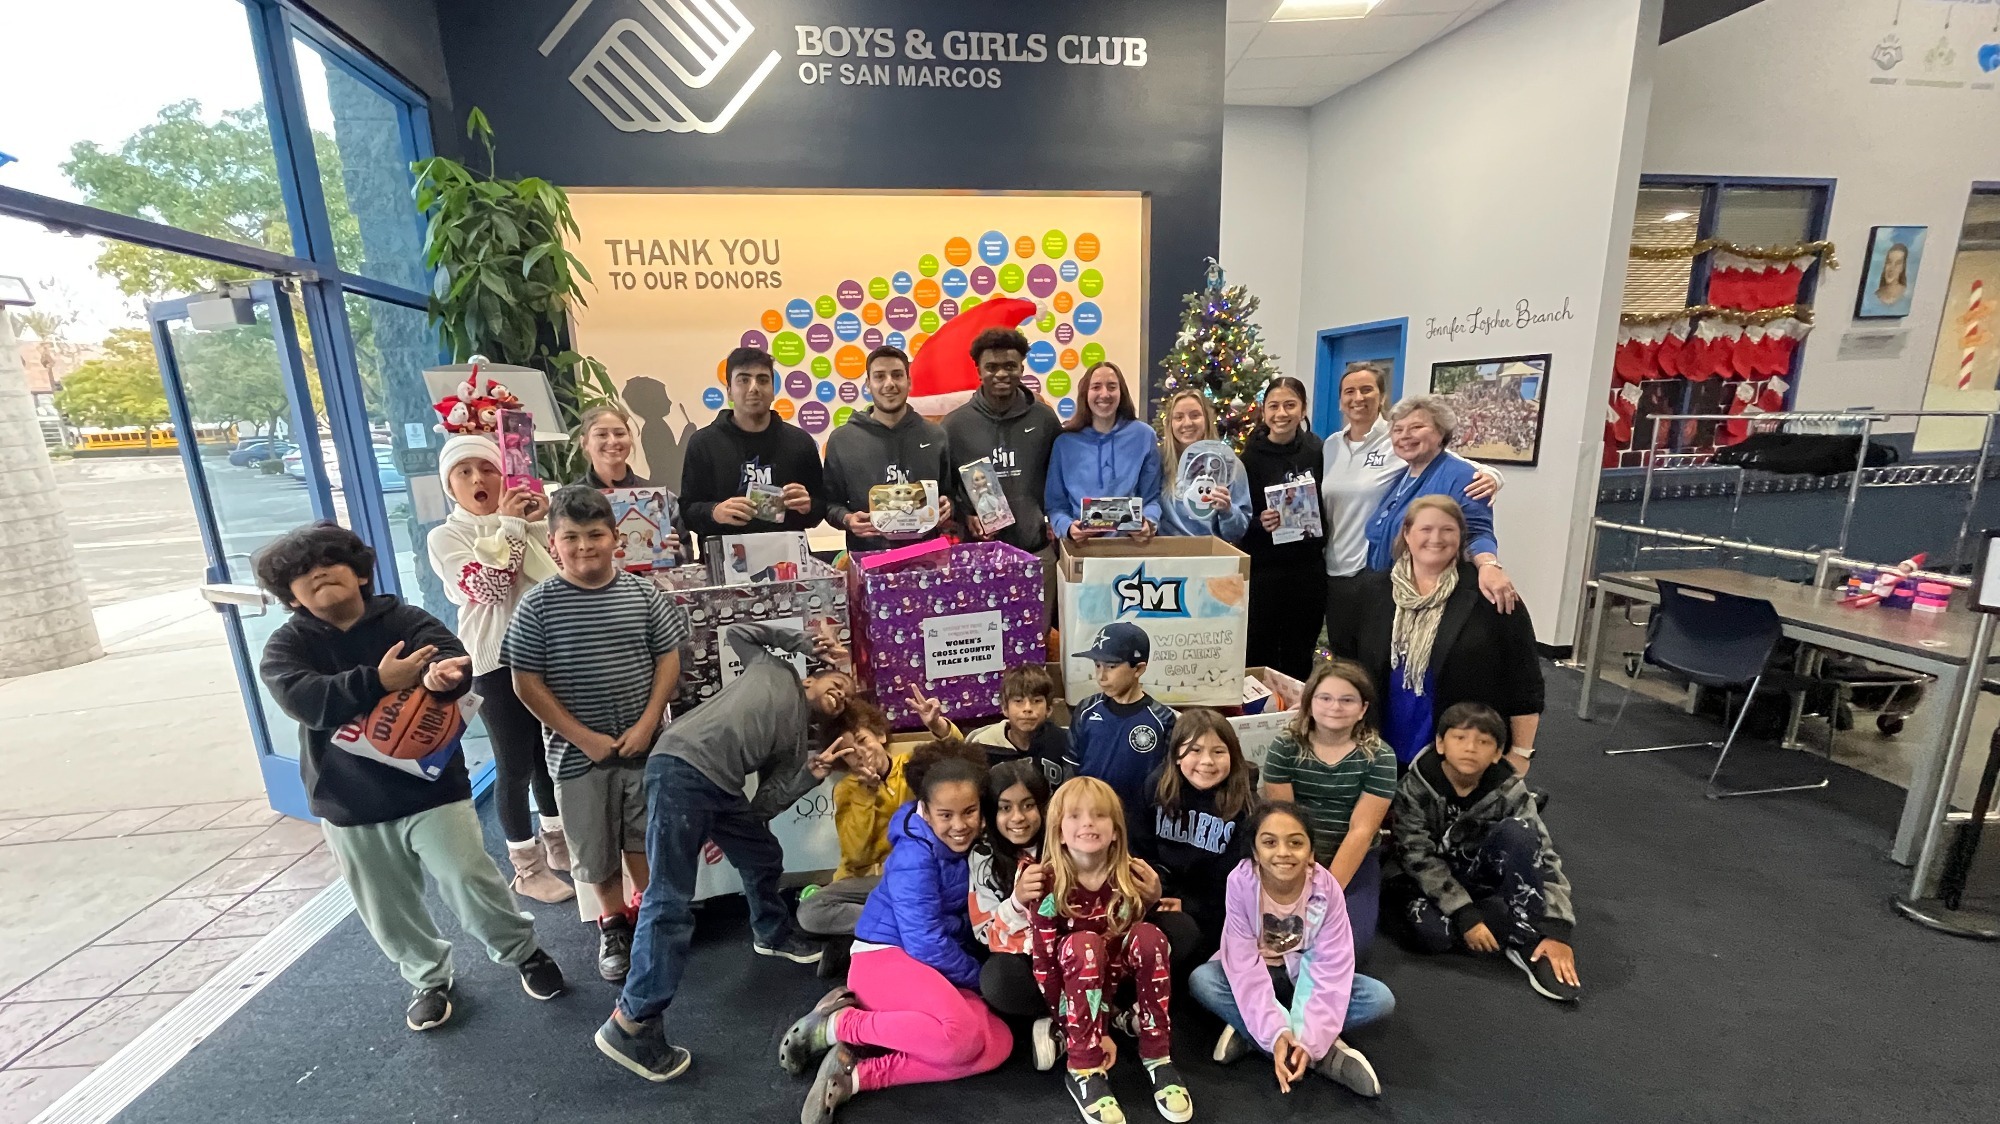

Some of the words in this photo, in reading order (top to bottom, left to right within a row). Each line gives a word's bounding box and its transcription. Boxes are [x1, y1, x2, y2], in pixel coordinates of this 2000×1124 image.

[794, 25, 896, 58] BOYS
[904, 29, 937, 60] &
[943, 30, 1048, 63] GIRLS
[1057, 34, 1148, 67] CLUB
[798, 62, 833, 85] OF
[839, 63, 890, 86] SAN
[897, 65, 1002, 89] MARCOS
[604, 239, 713, 266] THANK
[720, 238, 780, 266] YOU
[609, 271, 637, 290] TO
[643, 271, 688, 290] OUR
[695, 271, 783, 290] DONORS
[1425, 317, 1466, 342] Jennifer
[1512, 296, 1574, 329] Branch
[1366, 452, 1384, 466] SM
[743, 464, 772, 485] SM
[1116, 572, 1180, 612] SM
[932, 649, 957, 658] CROSS
[959, 644, 996, 655] COUNTRY
[945, 637, 982, 647] WOMEN'S
[936, 657, 962, 666] TRACK
[971, 654, 992, 662] FIELD
[1152, 650, 1178, 662] AND
[1164, 663, 1198, 676] GOLF
[416, 706, 448, 735] NBA
